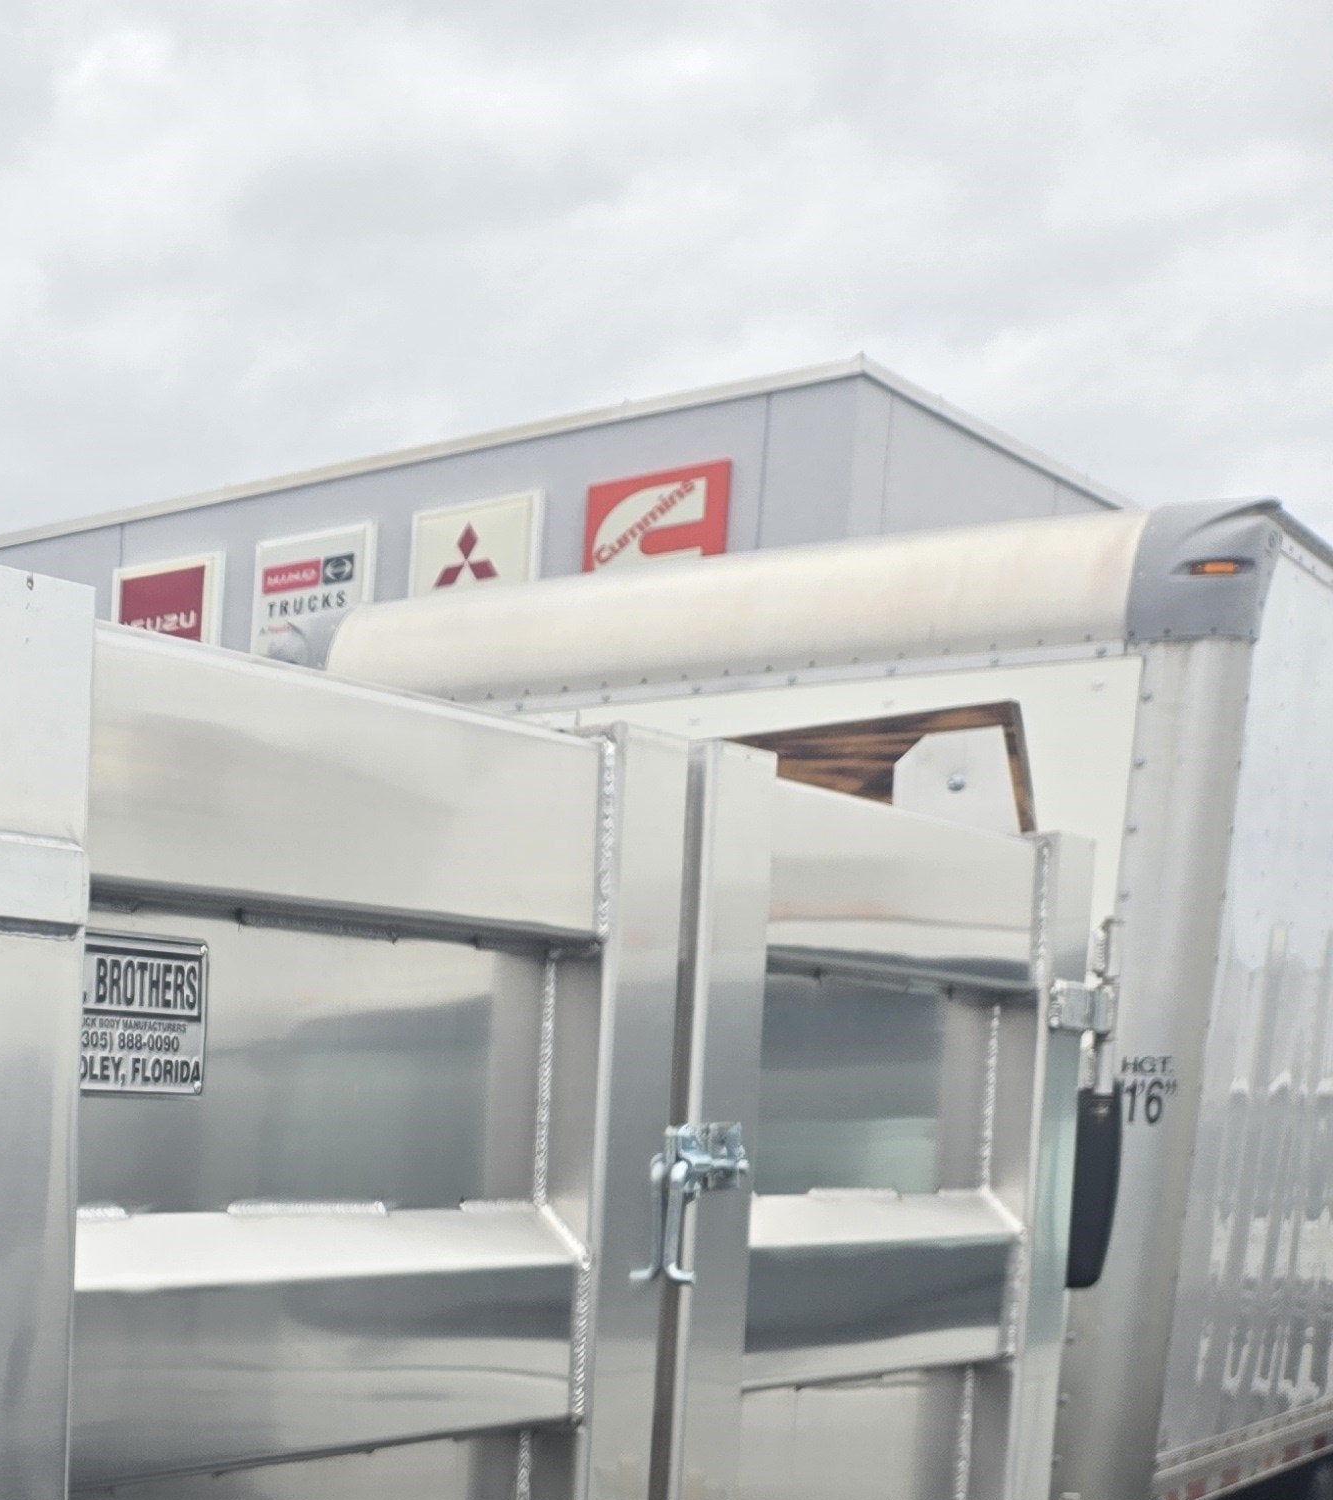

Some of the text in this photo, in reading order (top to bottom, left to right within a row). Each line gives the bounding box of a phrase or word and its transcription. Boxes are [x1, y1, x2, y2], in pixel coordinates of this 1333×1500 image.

[594, 480, 697, 564] Cummins
[267, 590, 347, 618] TRUCKS
[123, 609, 198, 633] SUZU
[95, 957, 198, 1011] BROTHERS
[121, 1020, 187, 1035] MANUFACTURERS
[81, 1030, 114, 1052] 305)
[131, 1057, 201, 1083] FLORIDA
